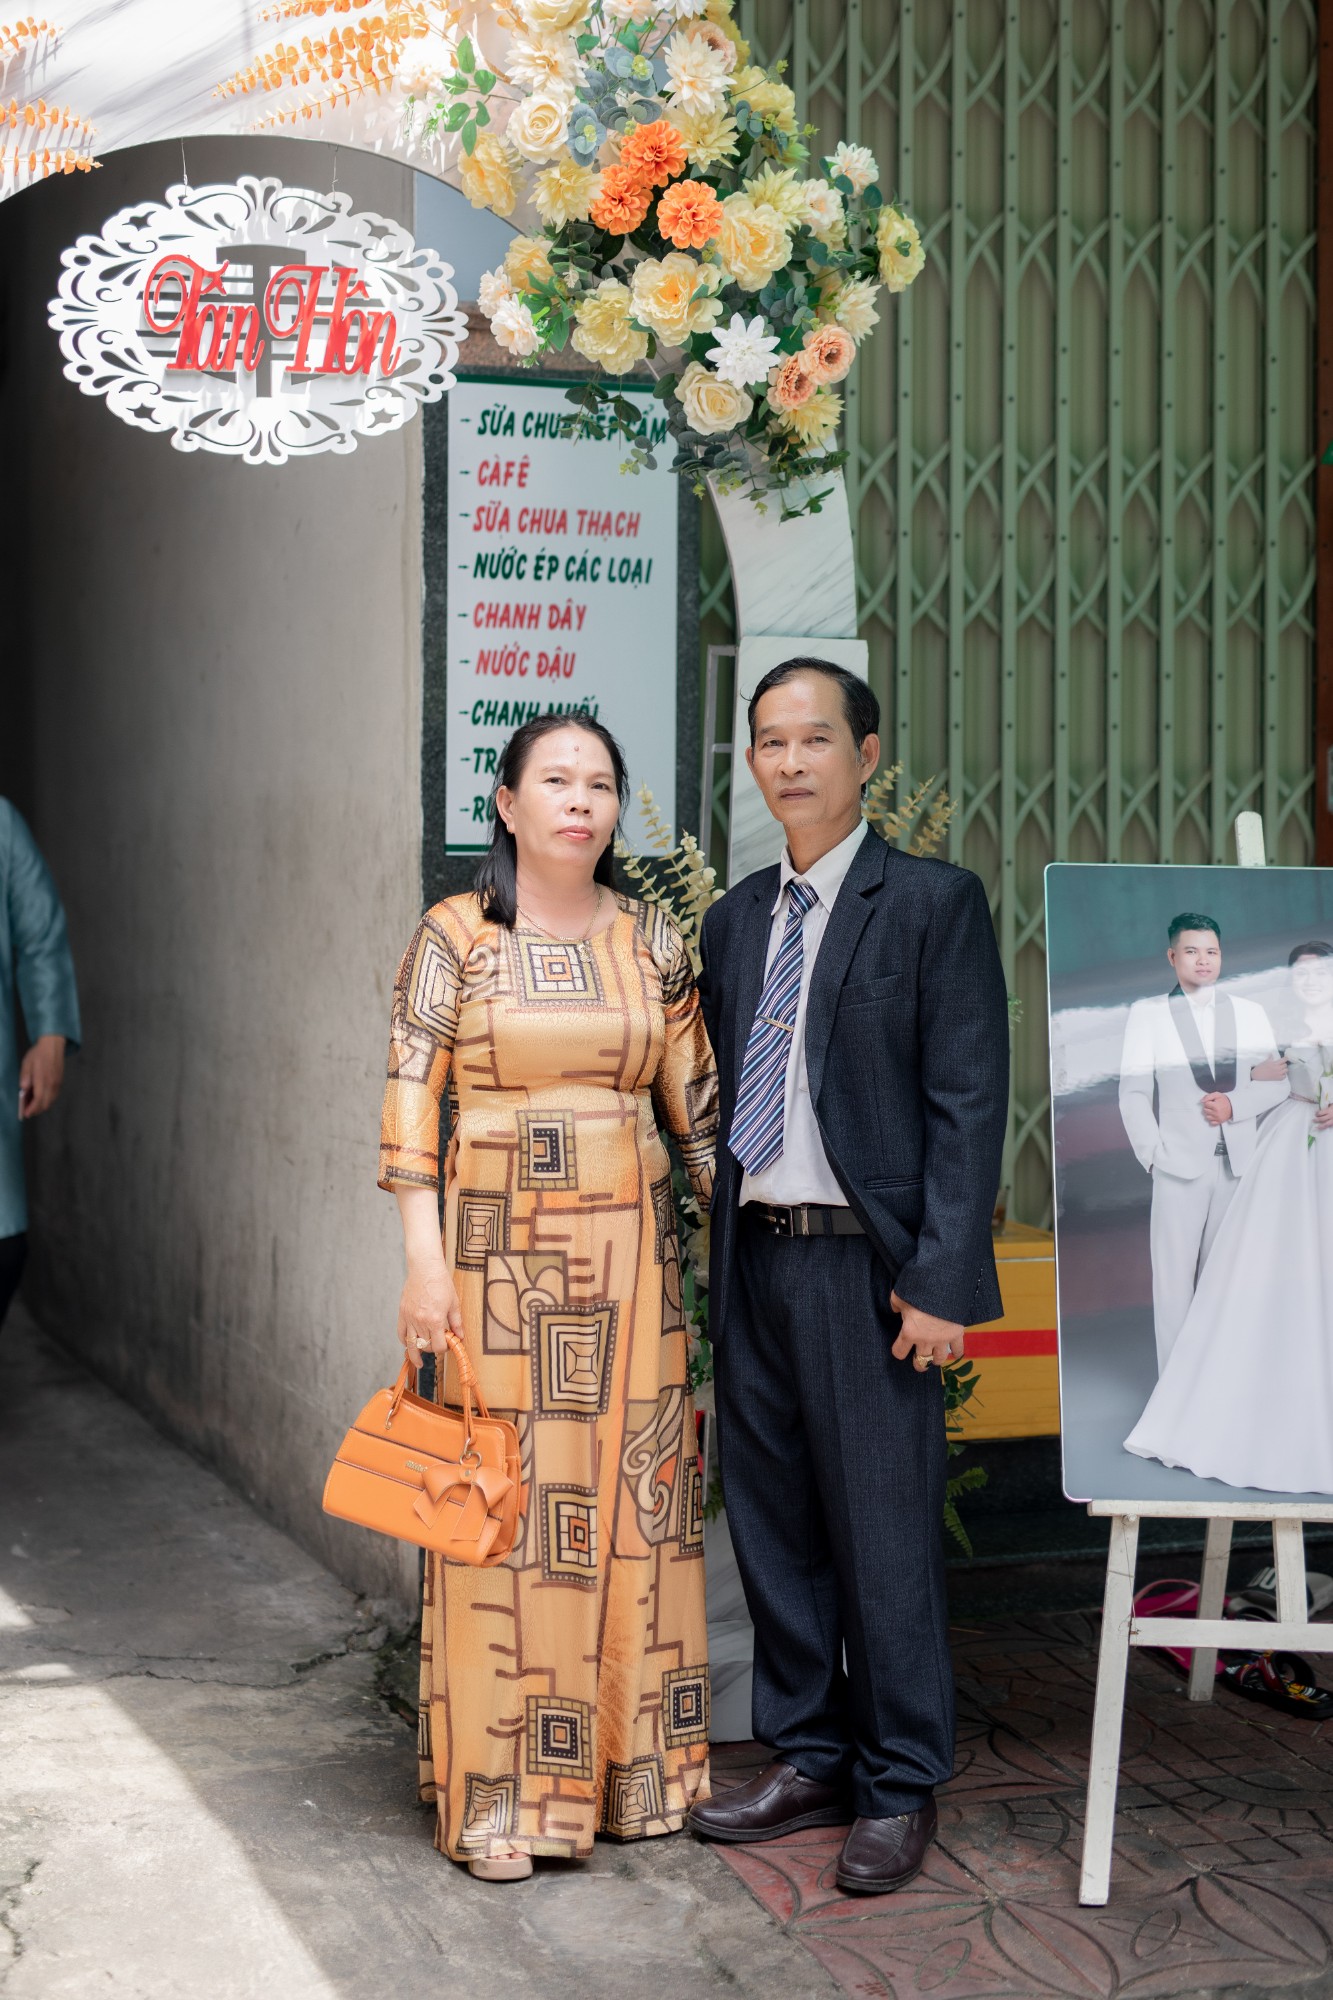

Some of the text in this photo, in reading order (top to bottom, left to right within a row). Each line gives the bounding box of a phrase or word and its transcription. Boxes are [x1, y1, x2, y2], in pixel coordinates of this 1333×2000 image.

[264, 264, 402, 377] Hôn
[477, 403, 515, 436] SỮA
[517, 507, 568, 535] CHUA
[577, 509, 641, 542] THẠCH
[473, 546, 653, 589] NƯỚC ÉP CÁC LOẠI
[473, 598, 587, 632] CHANH DÂY
[475, 641, 576, 684] NƯỚC ĐẬU
[471, 699, 541, 727] CHANH
